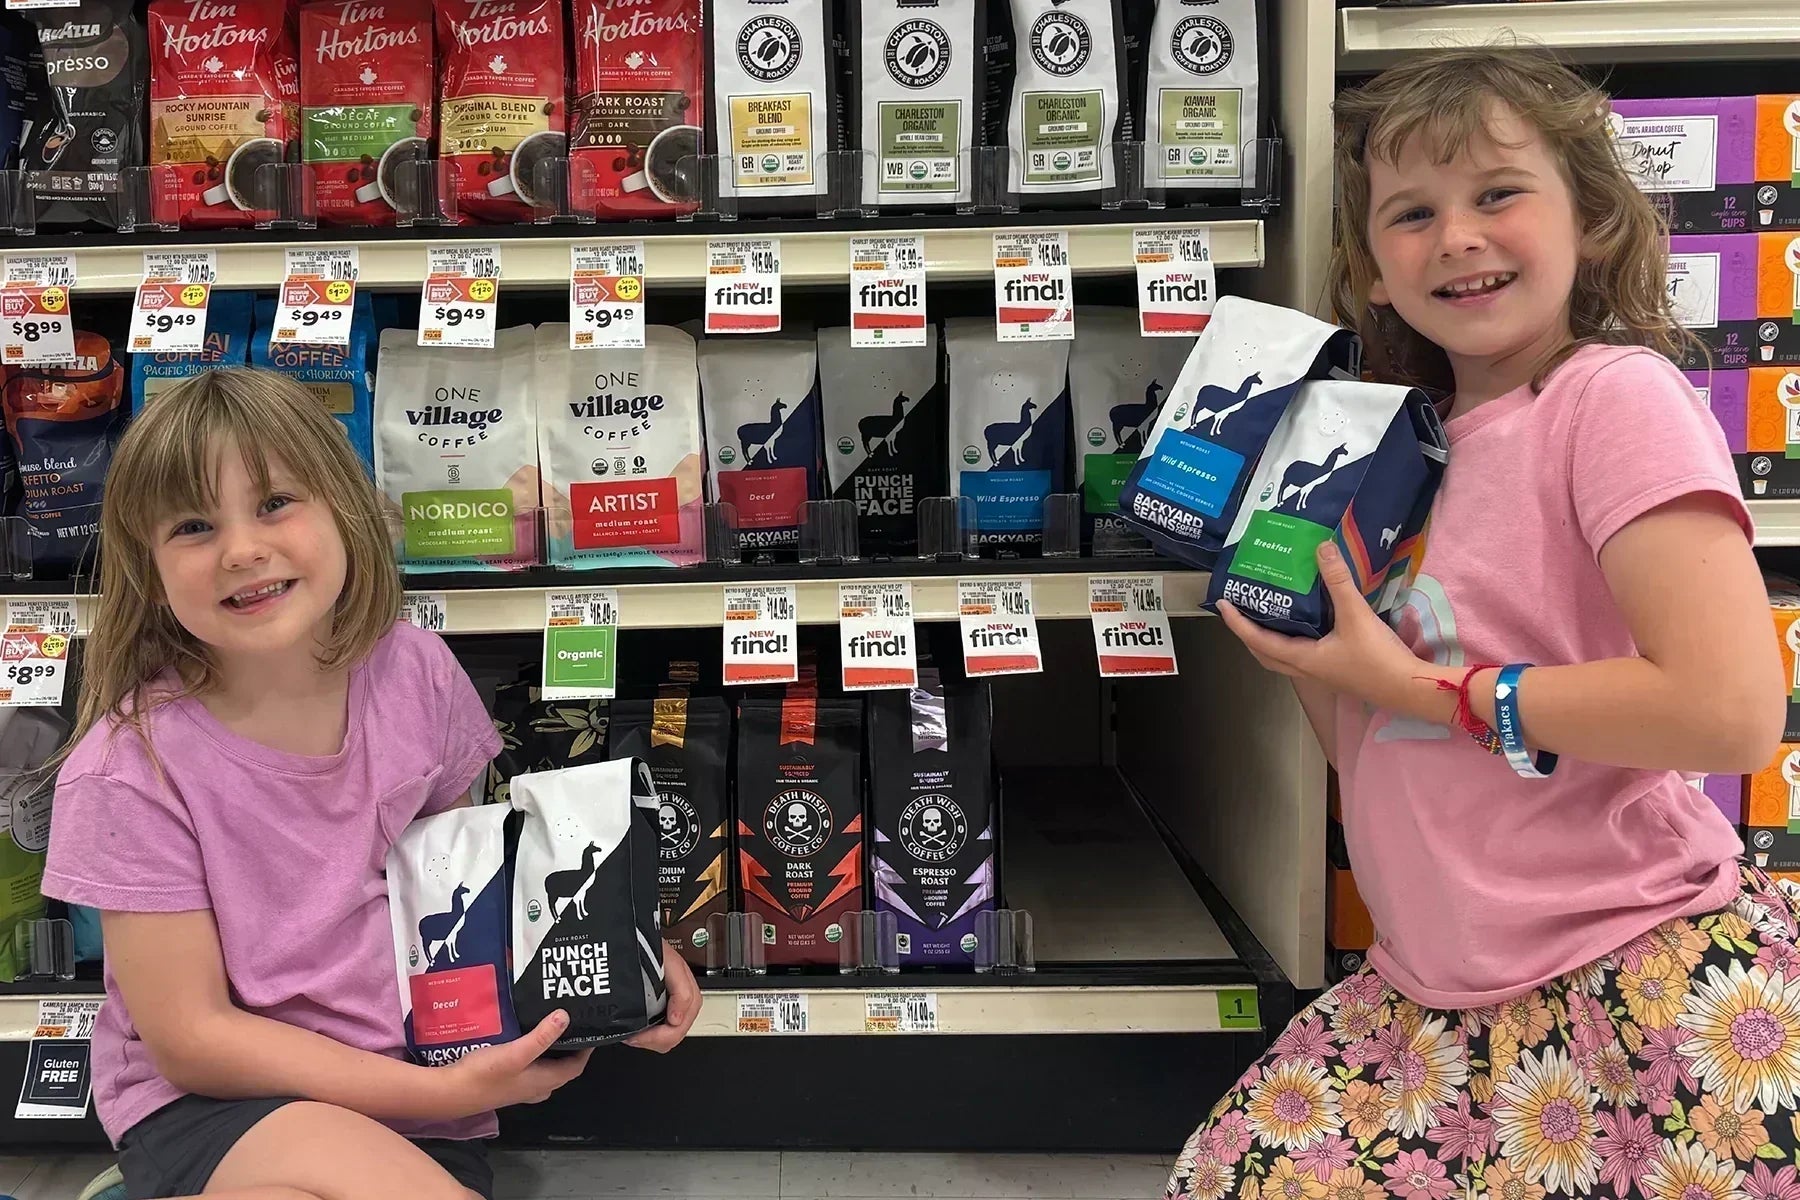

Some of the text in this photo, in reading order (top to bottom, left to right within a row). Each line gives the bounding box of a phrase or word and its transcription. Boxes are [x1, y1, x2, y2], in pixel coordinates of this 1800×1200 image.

[188, 0, 235, 22] Tim
[335, 0, 384, 25] Tim
[470, 0, 516, 19] Tim
[457, 17, 549, 52] Hortons
[584, 11, 684, 48] Hortons
[740, 16, 796, 42] CHARLESTON
[163, 25, 268, 58] Hortons
[316, 27, 418, 63] Hortons
[740, 53, 798, 78] COFFEE ROASTERS
[1032, 49, 1090, 74] COFFEE ROASTERS
[887, 60, 947, 85] COFFEE ROASTERS
[166, 102, 249, 113] ROCKY MOUNTAIN
[454, 102, 536, 113] ORIGINAL BLEND
[592, 97, 665, 106] DARK ROAST
[748, 101, 791, 112] BREAKFAST
[1038, 98, 1086, 109] CHARLESTON
[1184, 96, 1215, 106] KIAWAH
[186, 113, 226, 122] SUNRISE
[340, 111, 379, 121] DECAF
[758, 113, 782, 124] BLEND
[895, 108, 944, 120] CHARLESTON
[1046, 110, 1080, 121] ORGANIC
[1183, 107, 1216, 118] ORGANIC
[903, 120, 936, 131] ORGANIC
[1627, 125, 1684, 134] 100% ARABICA COFFEE
[1168, 148, 1180, 161] GR
[1632, 140, 1681, 159] Donut
[742, 157, 754, 169] GR
[1033, 154, 1044, 167] GR
[887, 163, 903, 175] WB
[1639, 159, 1674, 179] Shop
[1724, 197, 1736, 209] 12
[1721, 218, 1745, 228] CUPS
[878, 279, 904, 288] NEW
[1022, 274, 1049, 282] NEW
[1166, 274, 1192, 282] NEW
[734, 282, 759, 290] NEW
[1004, 279, 1065, 303] find!
[1147, 280, 1208, 303] find!
[579, 291, 597, 299] BUY
[715, 288, 772, 306] find!
[859, 285, 918, 308] find!
[1726, 333, 1738, 345] 12
[275, 353, 344, 367] COFFEE
[1724, 354, 1747, 364] CUPS
[307, 371, 355, 379] HORIZON
[594, 372, 639, 389] ONE
[435, 387, 481, 403] ONE
[569, 394, 664, 419] village
[406, 406, 503, 430] village
[584, 420, 652, 441] COFFEE
[417, 431, 488, 449] COFFEE
[1160, 454, 1217, 482] Wild Espresso
[855, 474, 913, 488] PUNCH
[749, 493, 775, 501] Decaf
[855, 487, 913, 500] IN THE
[999, 495, 1039, 503] Espresso
[589, 492, 660, 513] ARTIST
[856, 500, 913, 516] FACE
[410, 502, 508, 520] NORDICO
[1134, 492, 1204, 528] BACKYARD
[595, 518, 658, 528] medium roast
[1133, 503, 1177, 531] BEANS
[57, 528, 68, 538] NET
[69, 526, 79, 536] WT
[80, 525, 89, 535] 12
[1175, 528, 1201, 539] COMPANY
[1176, 522, 1202, 535] COFFEE
[1254, 538, 1292, 554] Breakfast
[1225, 579, 1293, 608] BACKYARD
[1224, 590, 1269, 615] BEANS
[1269, 604, 1290, 616] COFFEE
[1120, 622, 1146, 630] NEW
[749, 630, 774, 638] NEW
[867, 630, 892, 638] NEW
[1102, 627, 1163, 647] find!
[731, 635, 788, 655] find!
[848, 635, 906, 658] find!
[558, 648, 603, 661] Organic
[1501, 705, 1515, 748] Takacs
[672, 795, 695, 817] WISH
[768, 791, 827, 814] DEATH WISH
[903, 796, 962, 820] DEATH WISH
[787, 862, 812, 870] DARK
[913, 868, 957, 877] ESPRESSO
[921, 877, 949, 886] ROAST
[542, 942, 608, 962] PUNCH
[542, 958, 609, 978] IN THE
[543, 976, 611, 1000] FACE
[433, 999, 459, 1009] Decaf
[1234, 998, 1243, 1014] 1
[44, 1059, 79, 1069] Gluten
[40, 1070, 78, 1083] FREE
